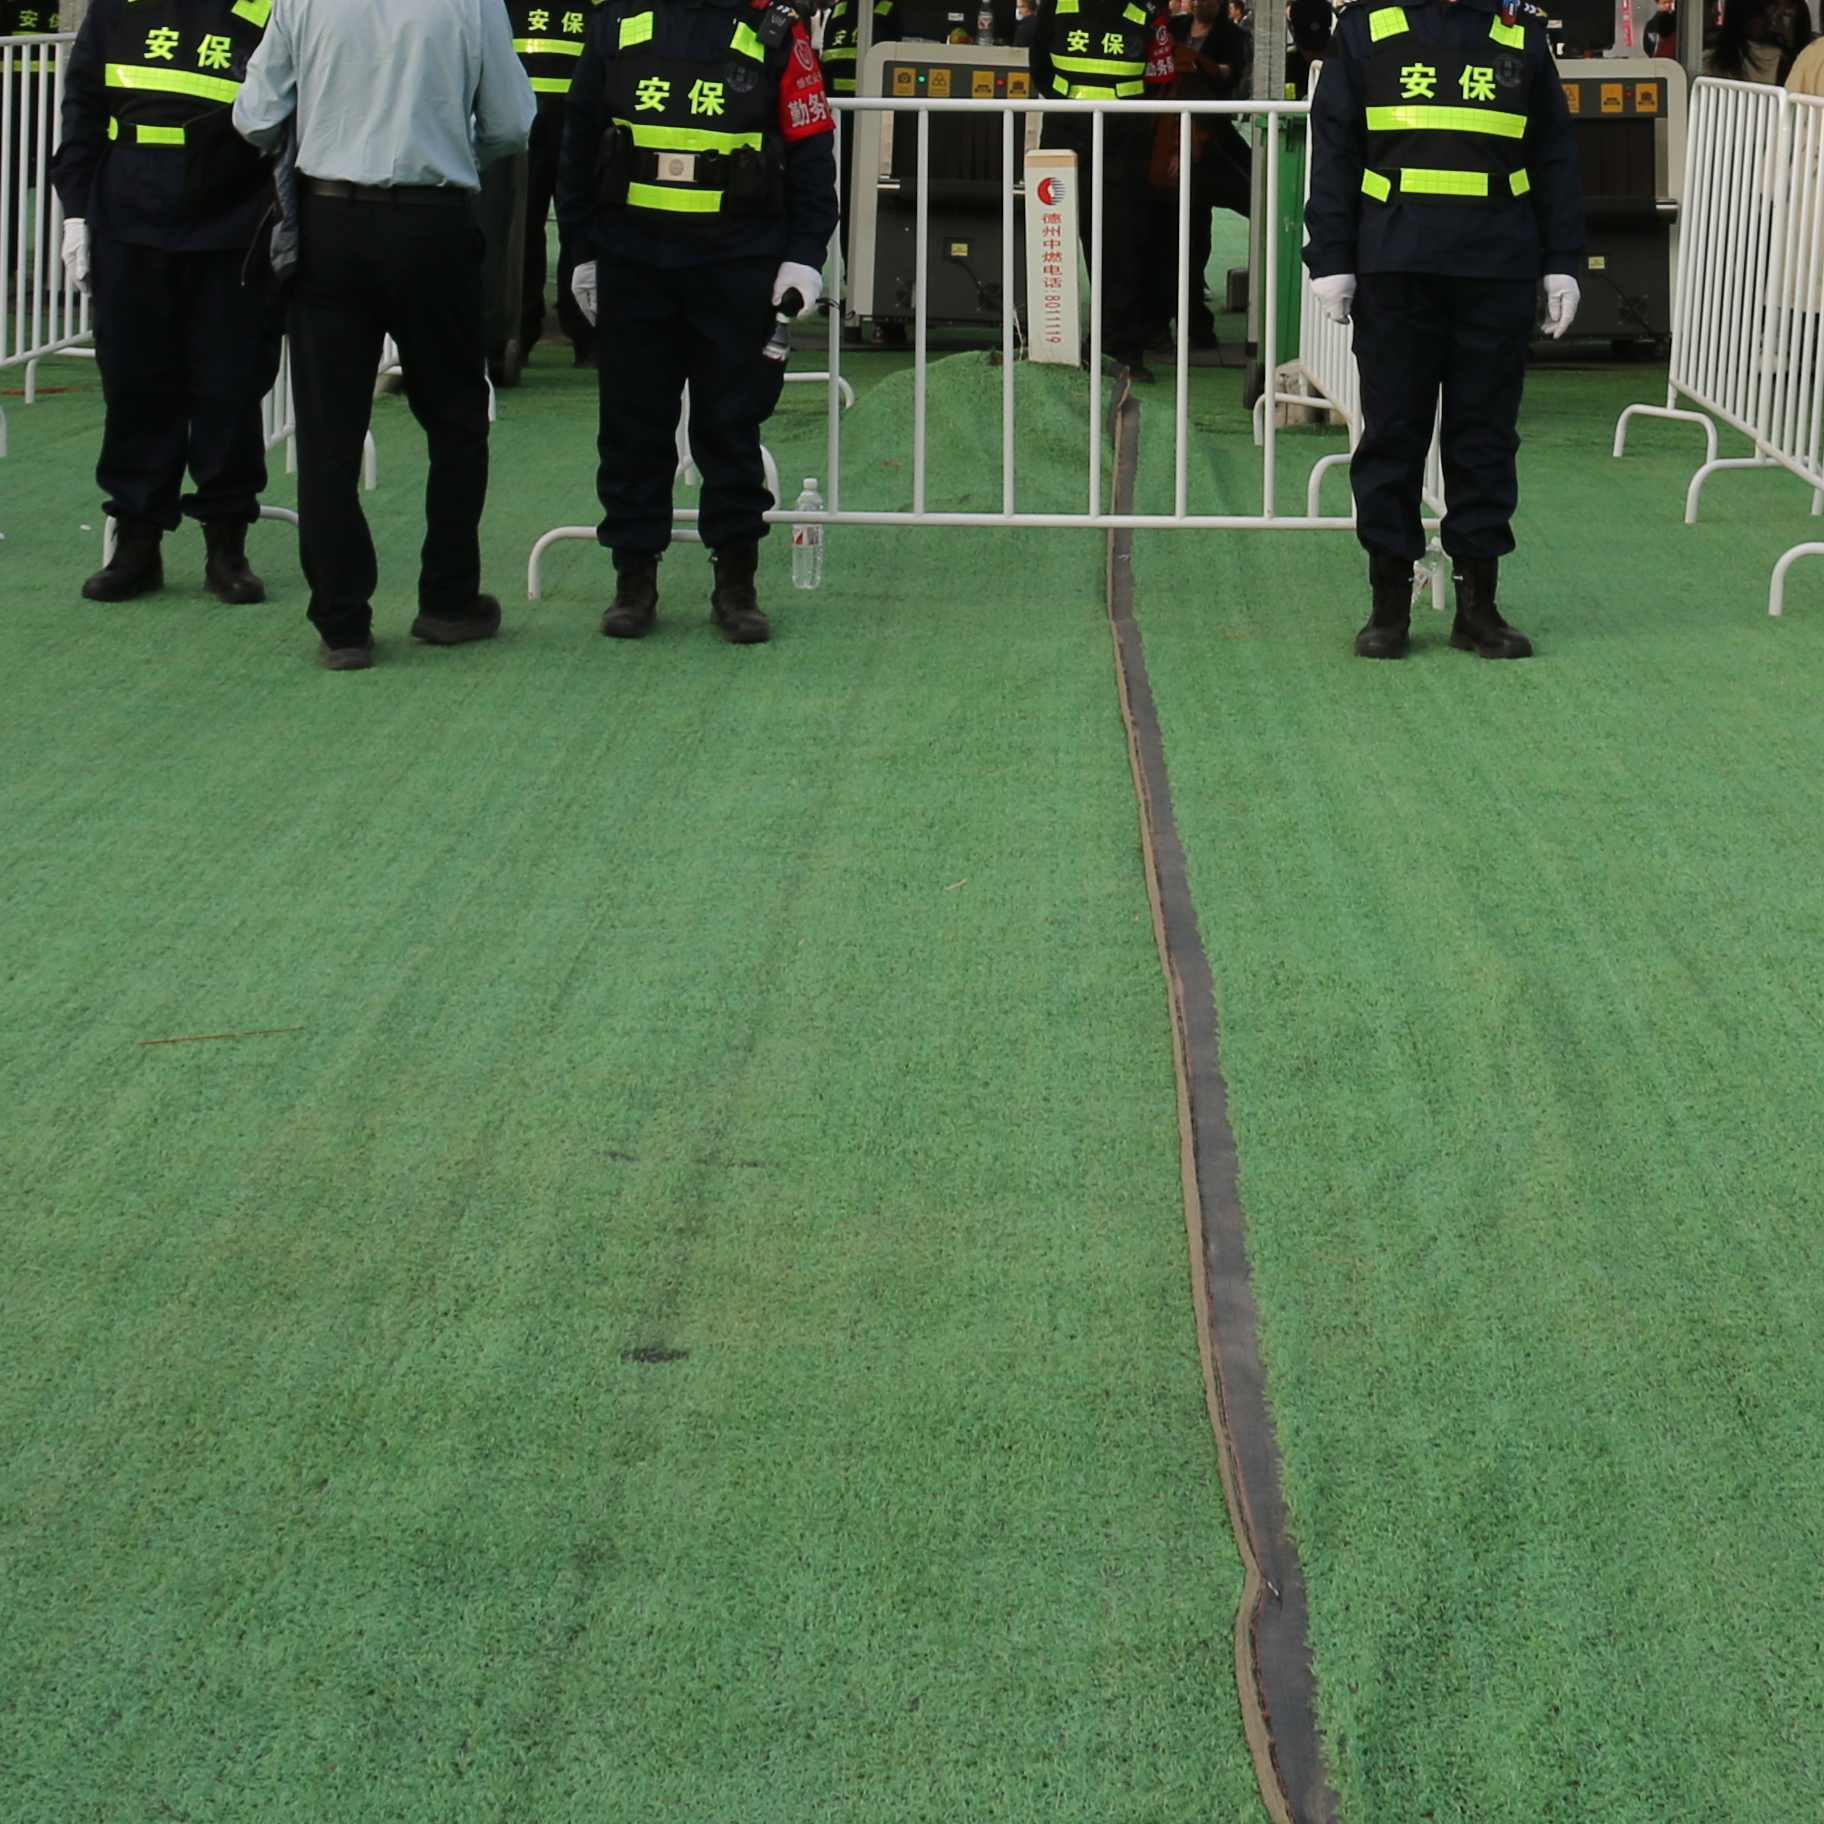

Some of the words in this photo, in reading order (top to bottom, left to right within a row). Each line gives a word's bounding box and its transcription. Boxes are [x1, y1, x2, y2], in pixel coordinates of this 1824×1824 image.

[527, 8, 584, 34] 安保
[143, 26, 232, 70] 安保
[1066, 29, 1125, 55] 安保
[635, 75, 726, 117] 安保
[1399, 63, 1497, 102] 安保
